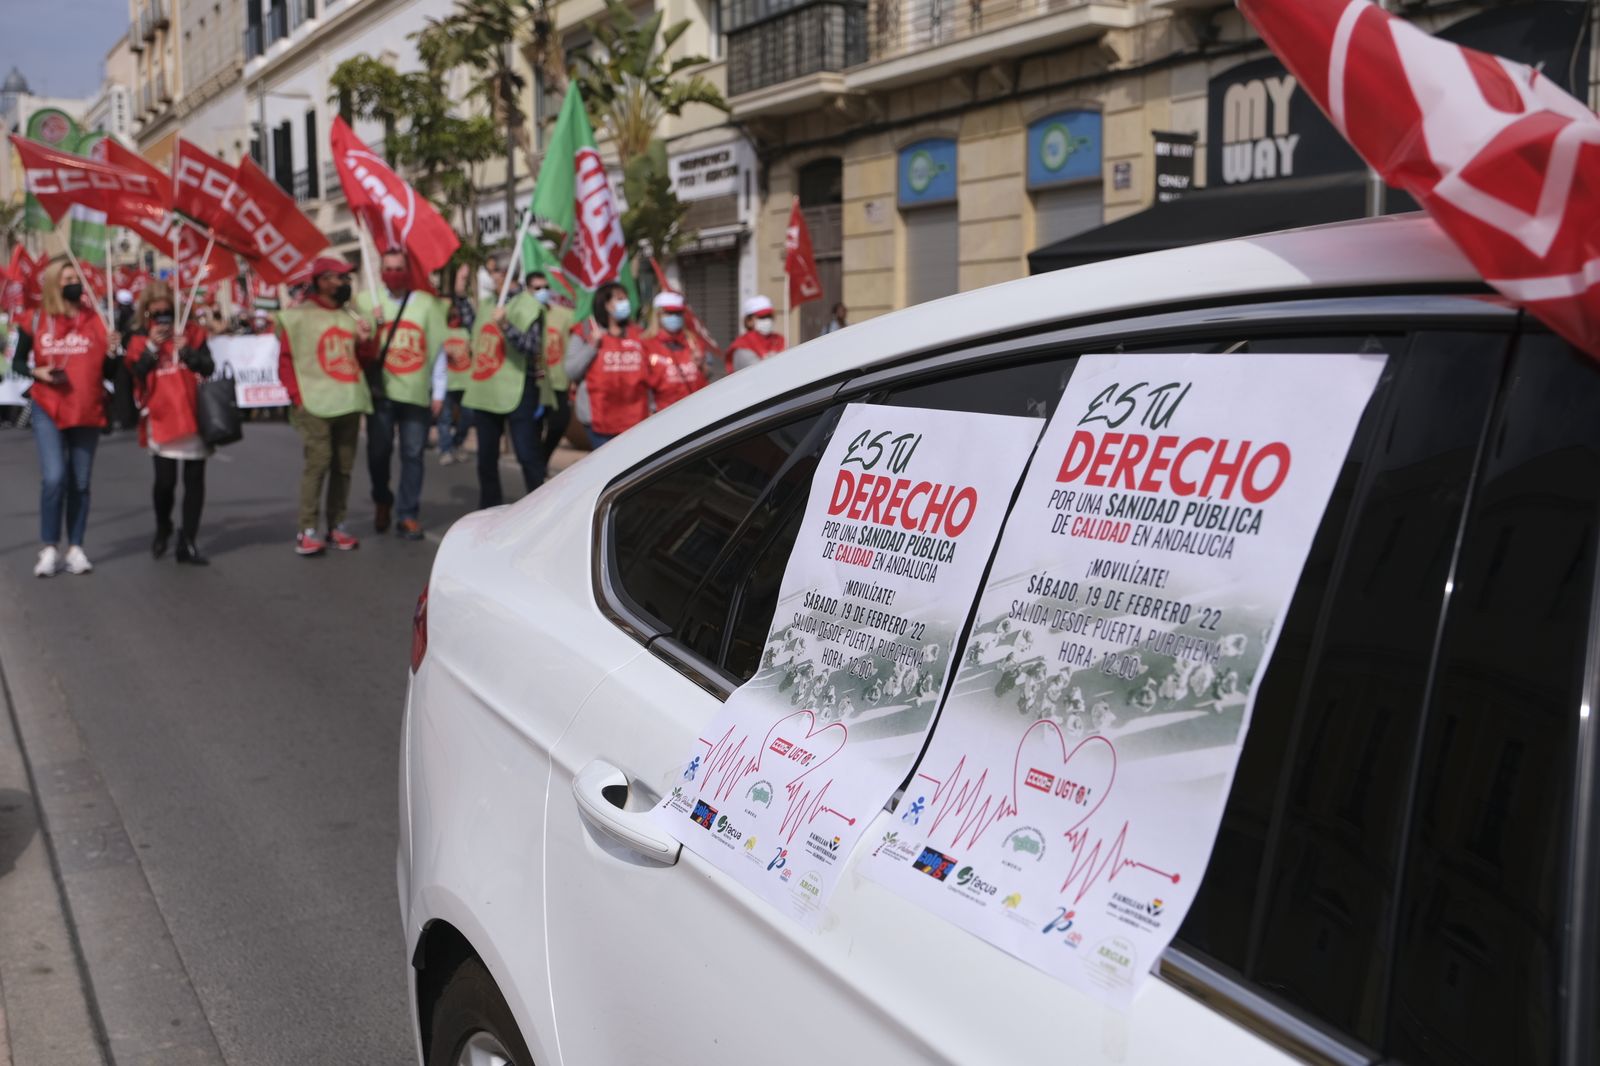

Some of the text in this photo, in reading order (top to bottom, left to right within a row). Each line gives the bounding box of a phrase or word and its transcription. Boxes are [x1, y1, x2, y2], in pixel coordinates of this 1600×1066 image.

[1223, 75, 1296, 143] MY
[1222, 134, 1299, 183] WAY
[221, 182, 303, 274] CCOO
[1077, 382, 1192, 430] ES TU
[840, 429, 922, 474] ES TU
[1055, 430, 1291, 503] DERECHO
[827, 469, 978, 538] DERECHO
[1048, 489, 1264, 535] POR UNA SANIDAD PÚBLICA
[821, 520, 957, 563] POR UNA SANIDAD PÚBLICA
[1051, 513, 1236, 559] DE CALIDAD EN ANDALUCÍA
[822, 541, 938, 583] DE CALIDAD EN ANDALUCÍA
[1085, 558, 1170, 589] ¡MOVILÍZATE!
[842, 579, 896, 606] ¡MOVILÍZATE!
[1085, 585, 1102, 607] 19
[1104, 590, 1124, 611] DE
[1125, 594, 1191, 625] FEBRERO
[840, 602, 852, 620] 19
[852, 605, 866, 624] DE
[866, 609, 908, 636] FEBRERO
[1008, 599, 1221, 665] SALIDA DESDE PUERTA PURCHENA
[791, 612, 925, 670] SALIDA DESDE PUERTA PURCHENA
[1057, 640, 1142, 680] HORA: 12:00
[821, 647, 873, 680] HORA: 12:00
[787, 746, 808, 764] UGT
[1054, 778, 1078, 801] UGT
[725, 822, 742, 840] facua
[970, 875, 998, 896] facua
